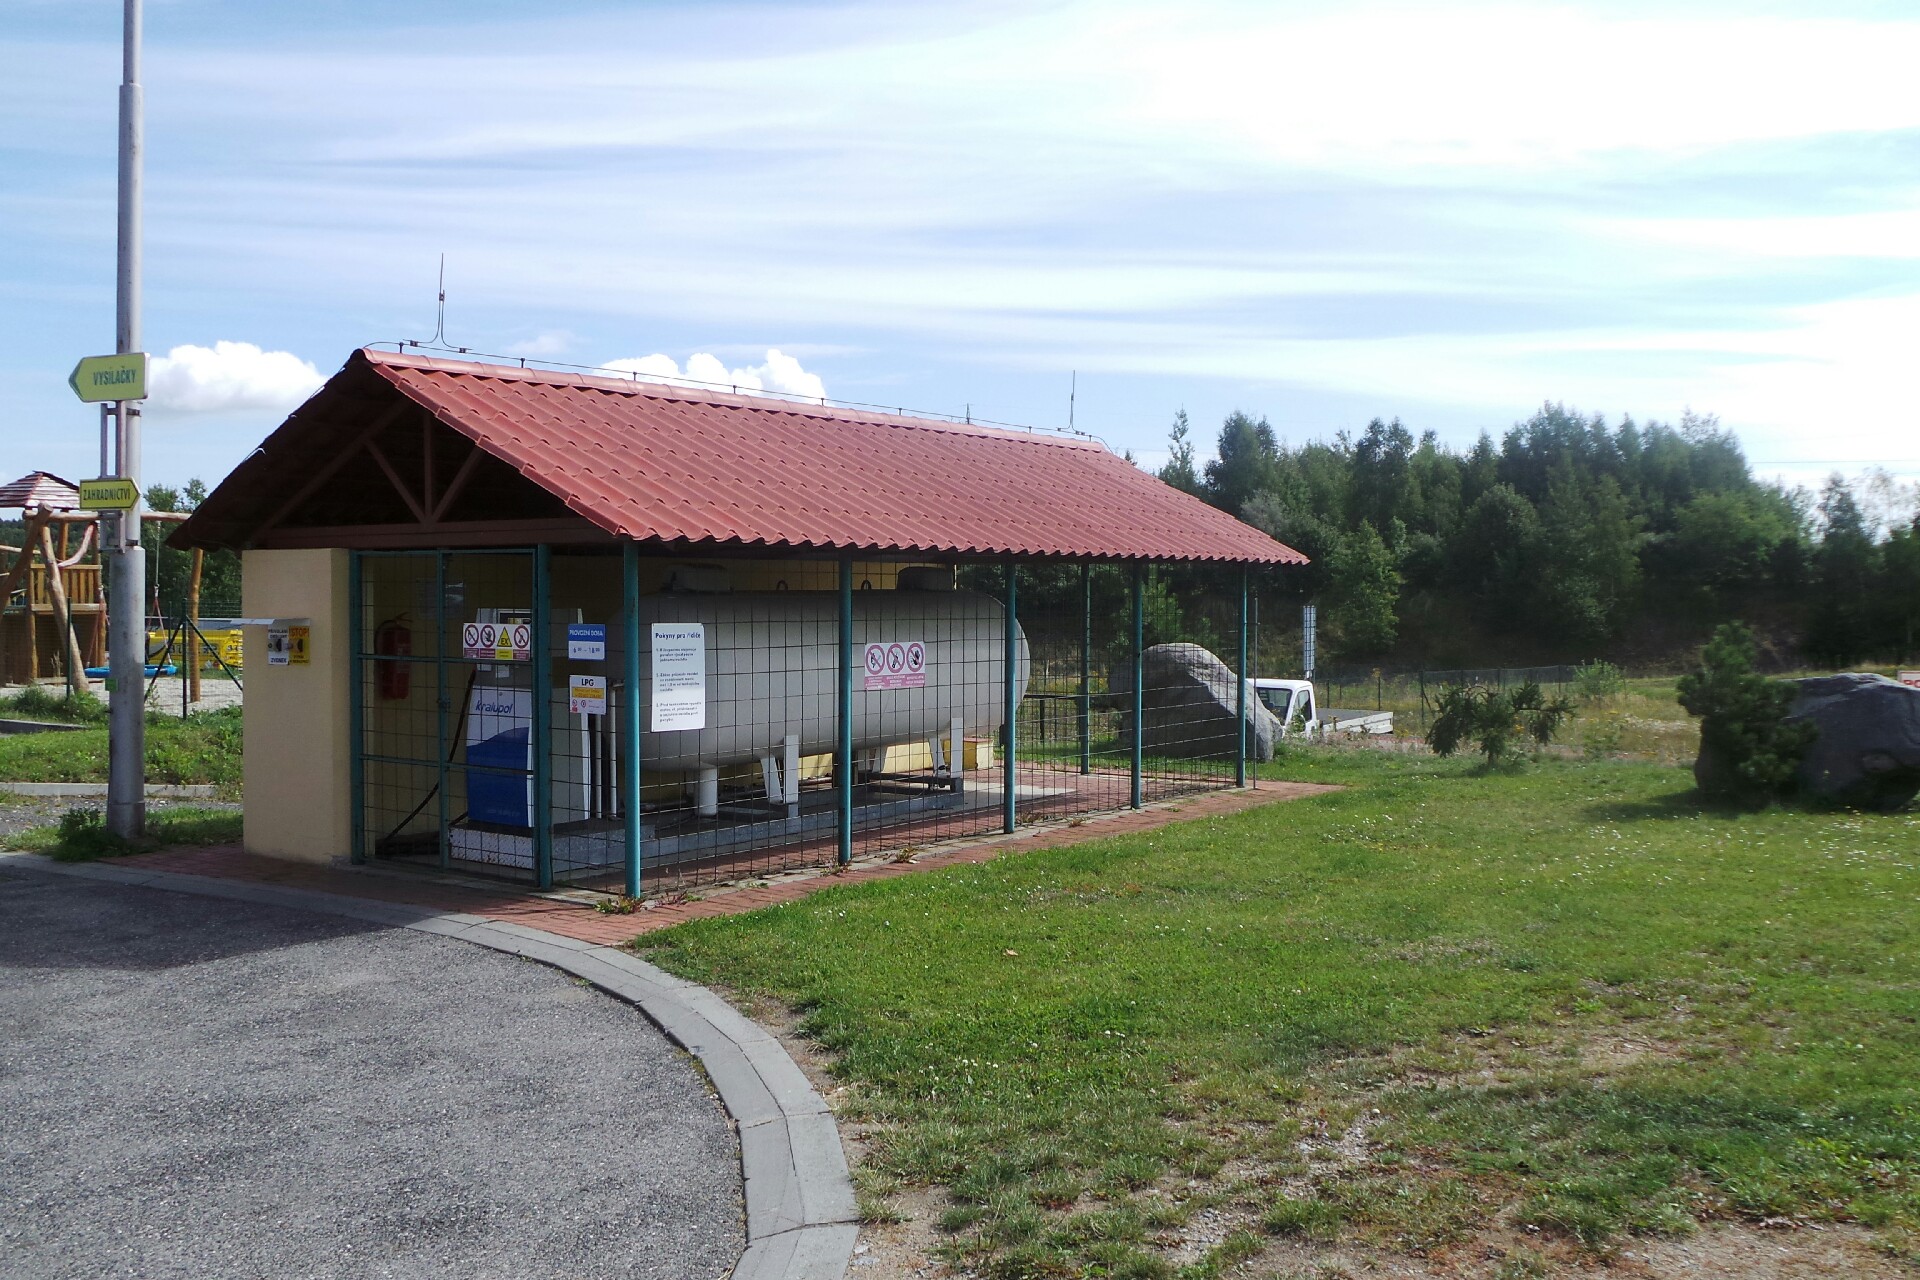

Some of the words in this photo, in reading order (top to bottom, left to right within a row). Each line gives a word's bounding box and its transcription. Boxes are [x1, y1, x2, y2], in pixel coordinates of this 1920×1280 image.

[655, 632, 676, 640] Pokyny
[581, 678, 594, 687] LPG
[475, 700, 514, 714] kralupol
